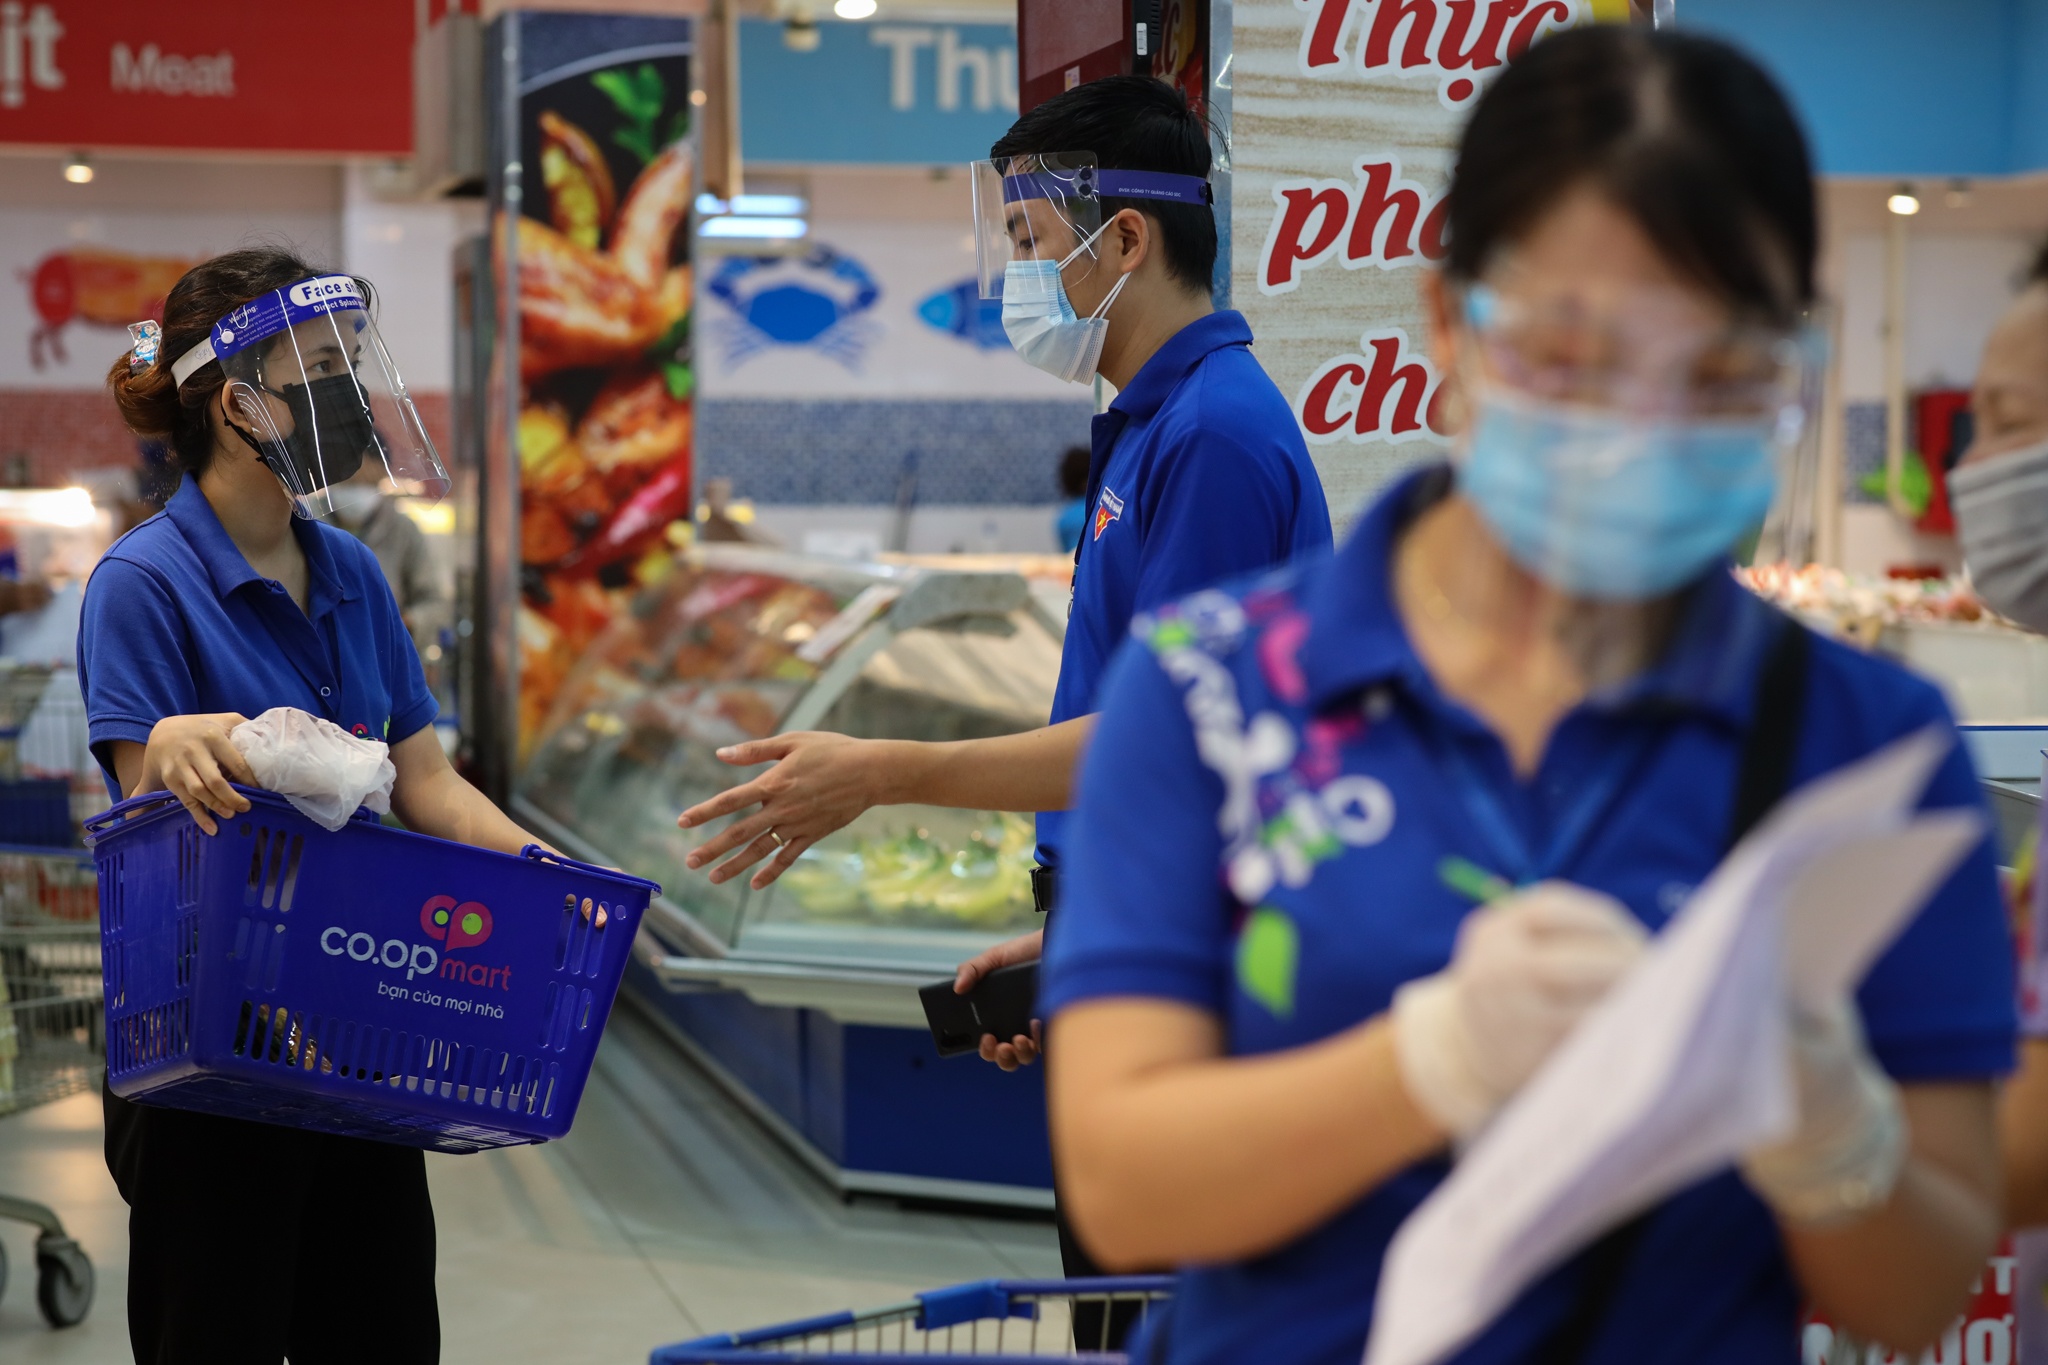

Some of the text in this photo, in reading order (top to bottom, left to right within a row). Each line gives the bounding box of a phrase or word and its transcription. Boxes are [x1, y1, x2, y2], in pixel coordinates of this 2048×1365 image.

[110, 43, 234, 96] Meat
[302, 283, 342, 300] Face
[320, 926, 512, 991] co.op mart
[377, 981, 504, 1019] bạn của mọi nhà
